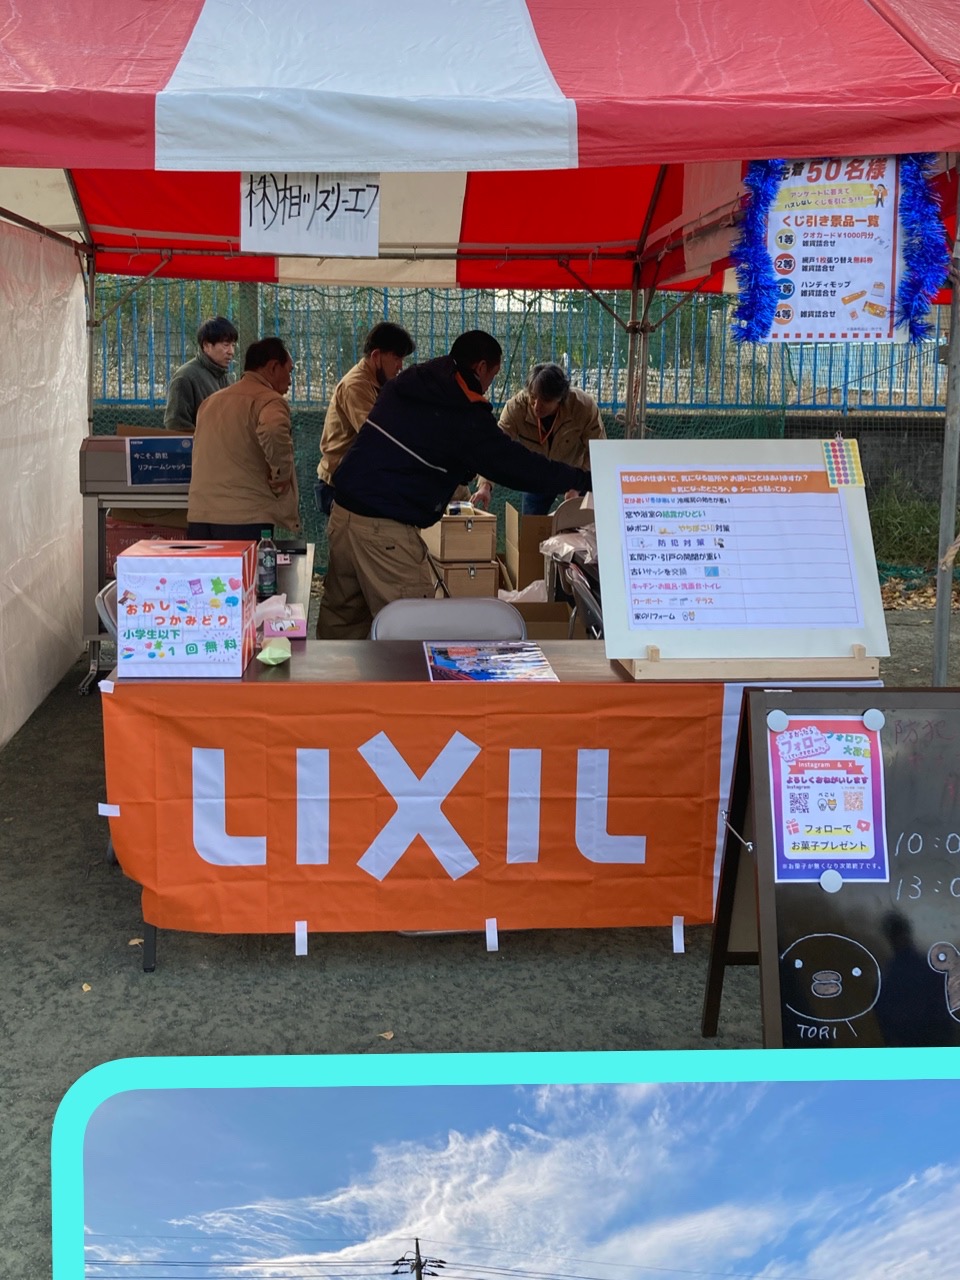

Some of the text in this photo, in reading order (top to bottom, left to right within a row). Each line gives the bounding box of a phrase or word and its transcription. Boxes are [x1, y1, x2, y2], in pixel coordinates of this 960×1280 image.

[782, 214, 880, 229] くじ引き景品一覧
[777, 233, 794, 246] 1等
[776, 259, 794, 271] 2等
[800, 280, 851, 289] ハンディモップ
[774, 308, 792, 320] 4等
[126, 601, 171, 616] おかし
[155, 614, 229, 627] つかみどり
[122, 628, 181, 641] 小学生以下
[780, 736, 825, 755] フォロー
[798, 761, 831, 770] Instagram
[786, 776, 869, 785] よろしくおねがいします
[192, 730, 647, 882] LIXIL
[804, 823, 852, 834] フォローで
[791, 840, 868, 852] お菓子プレゼント
[797, 1023, 837, 1039] TORI
